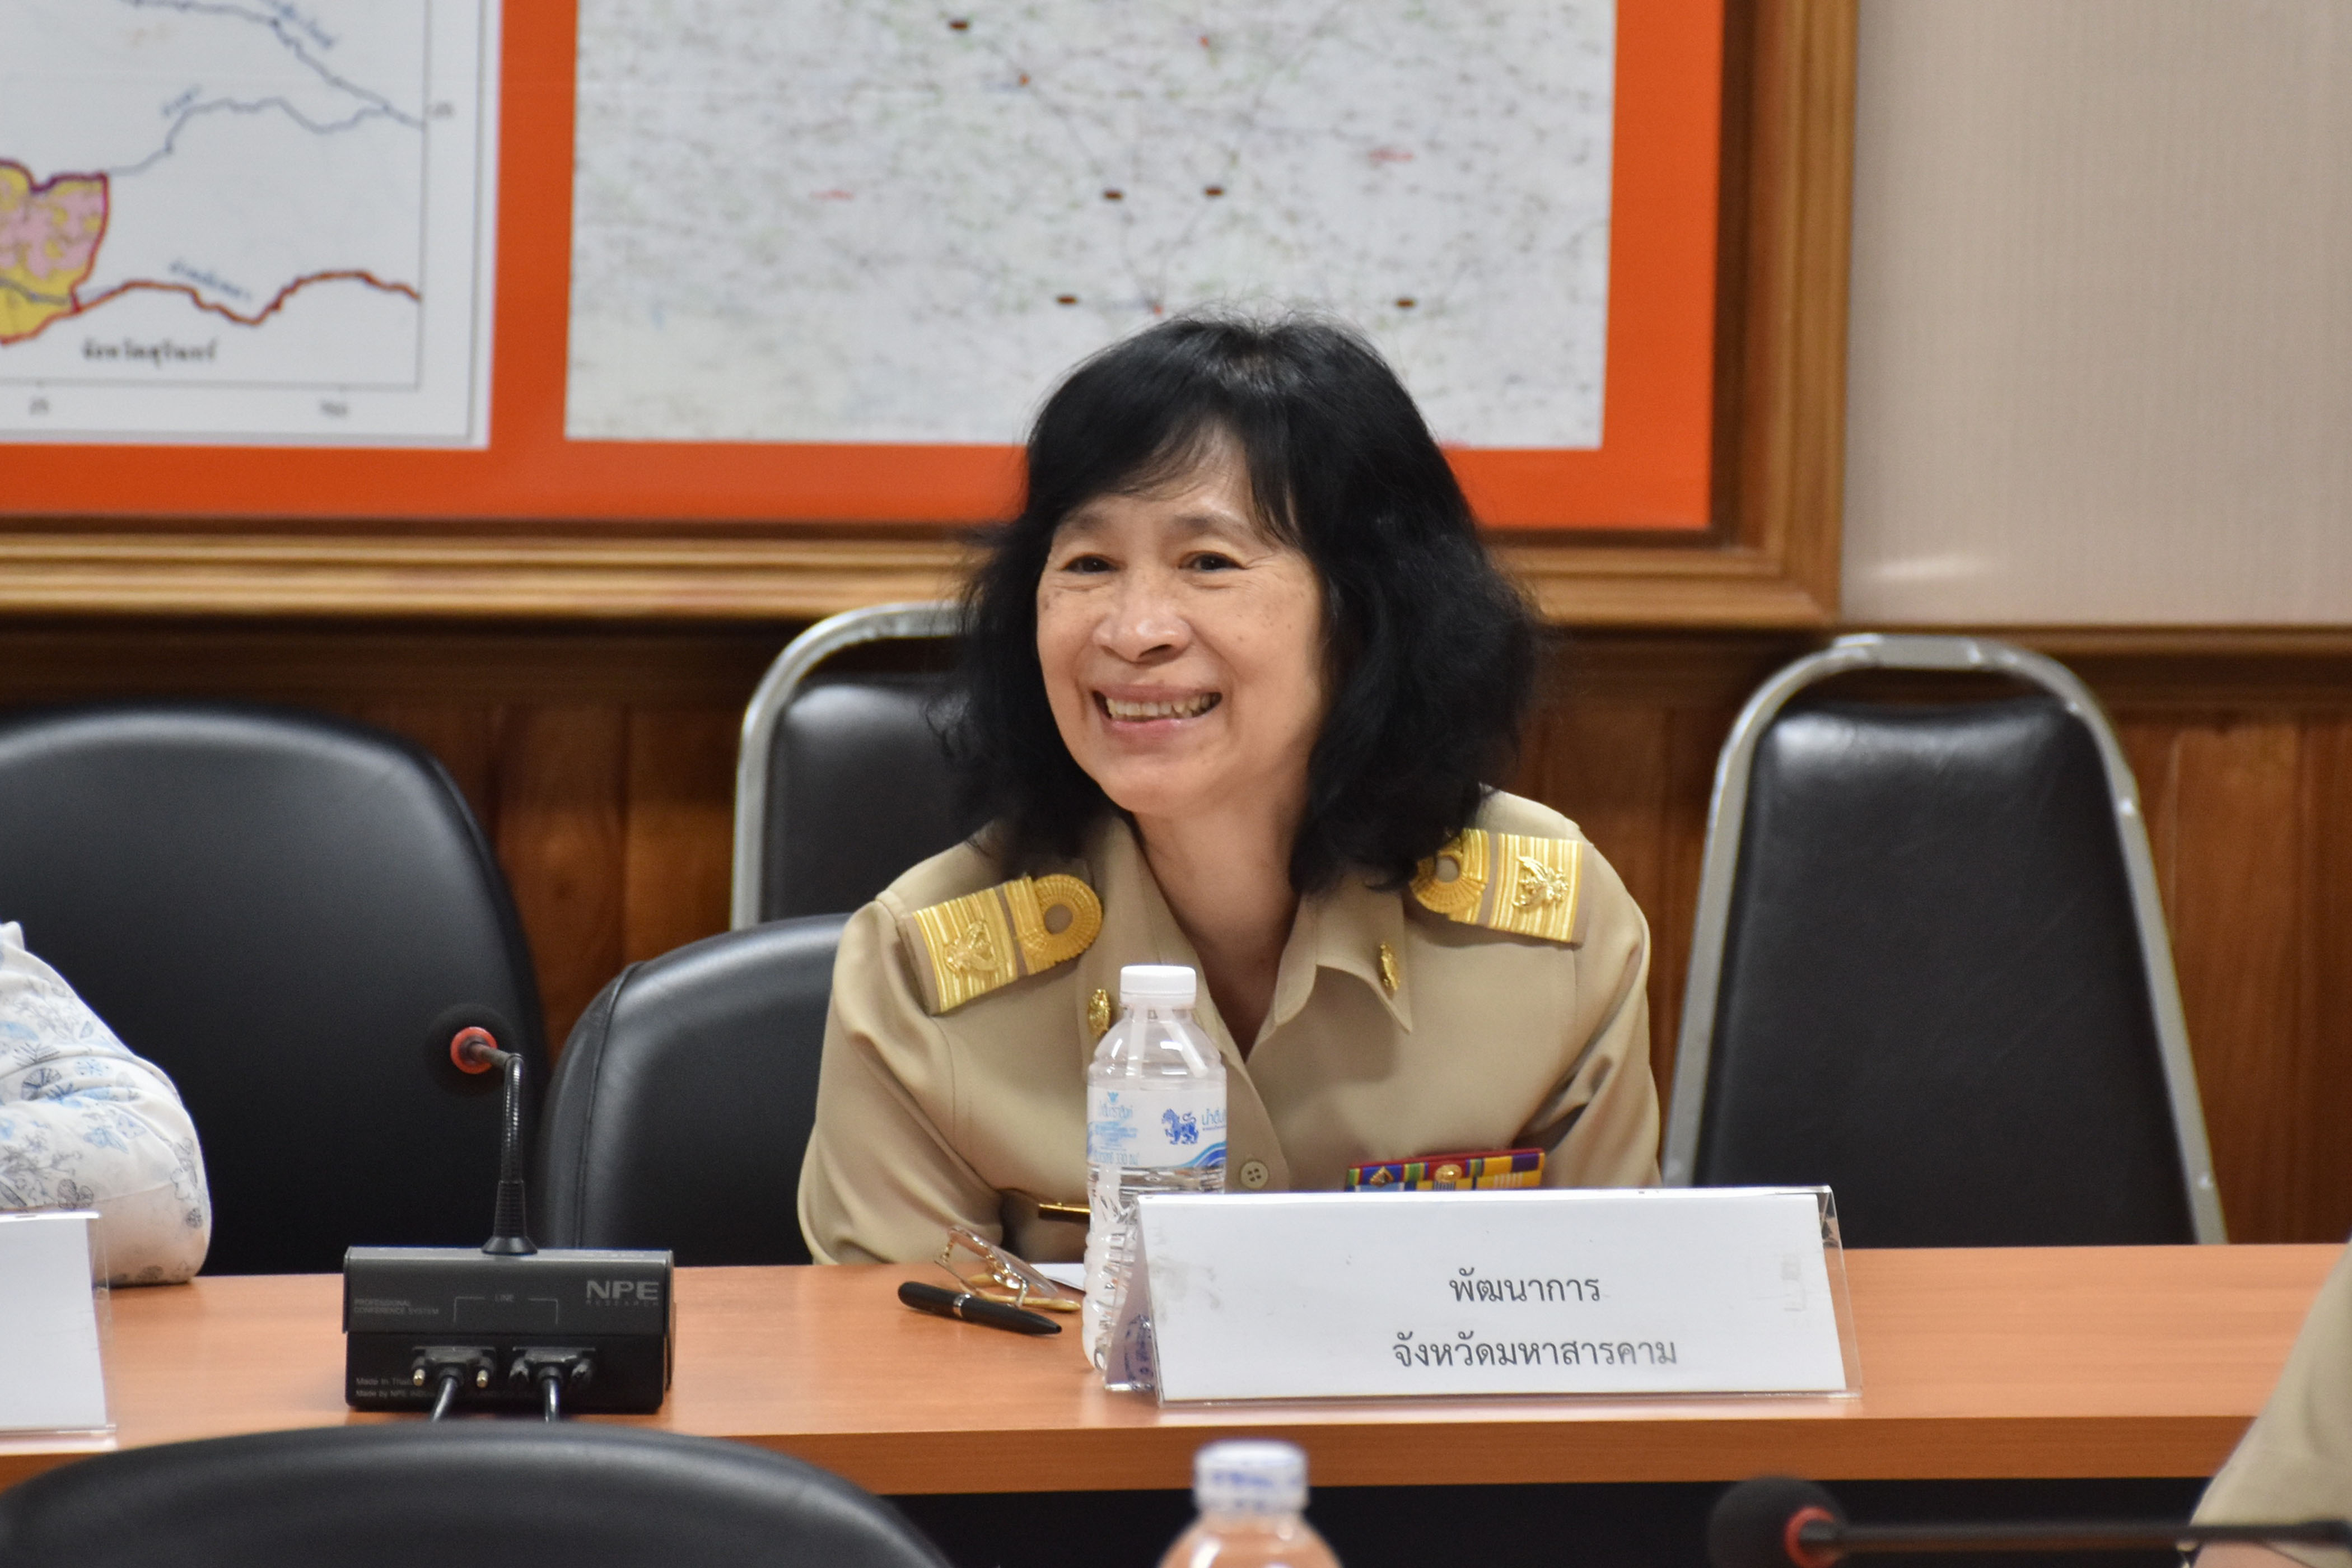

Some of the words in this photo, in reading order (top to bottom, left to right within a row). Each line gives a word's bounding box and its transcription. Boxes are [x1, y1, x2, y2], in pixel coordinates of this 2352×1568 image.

[586, 1280, 659, 1300] NPE
[1449, 1267, 1600, 1302] พัฒนาการ
[1393, 1331, 1677, 1367] จังหวัดมหาสารคาม
